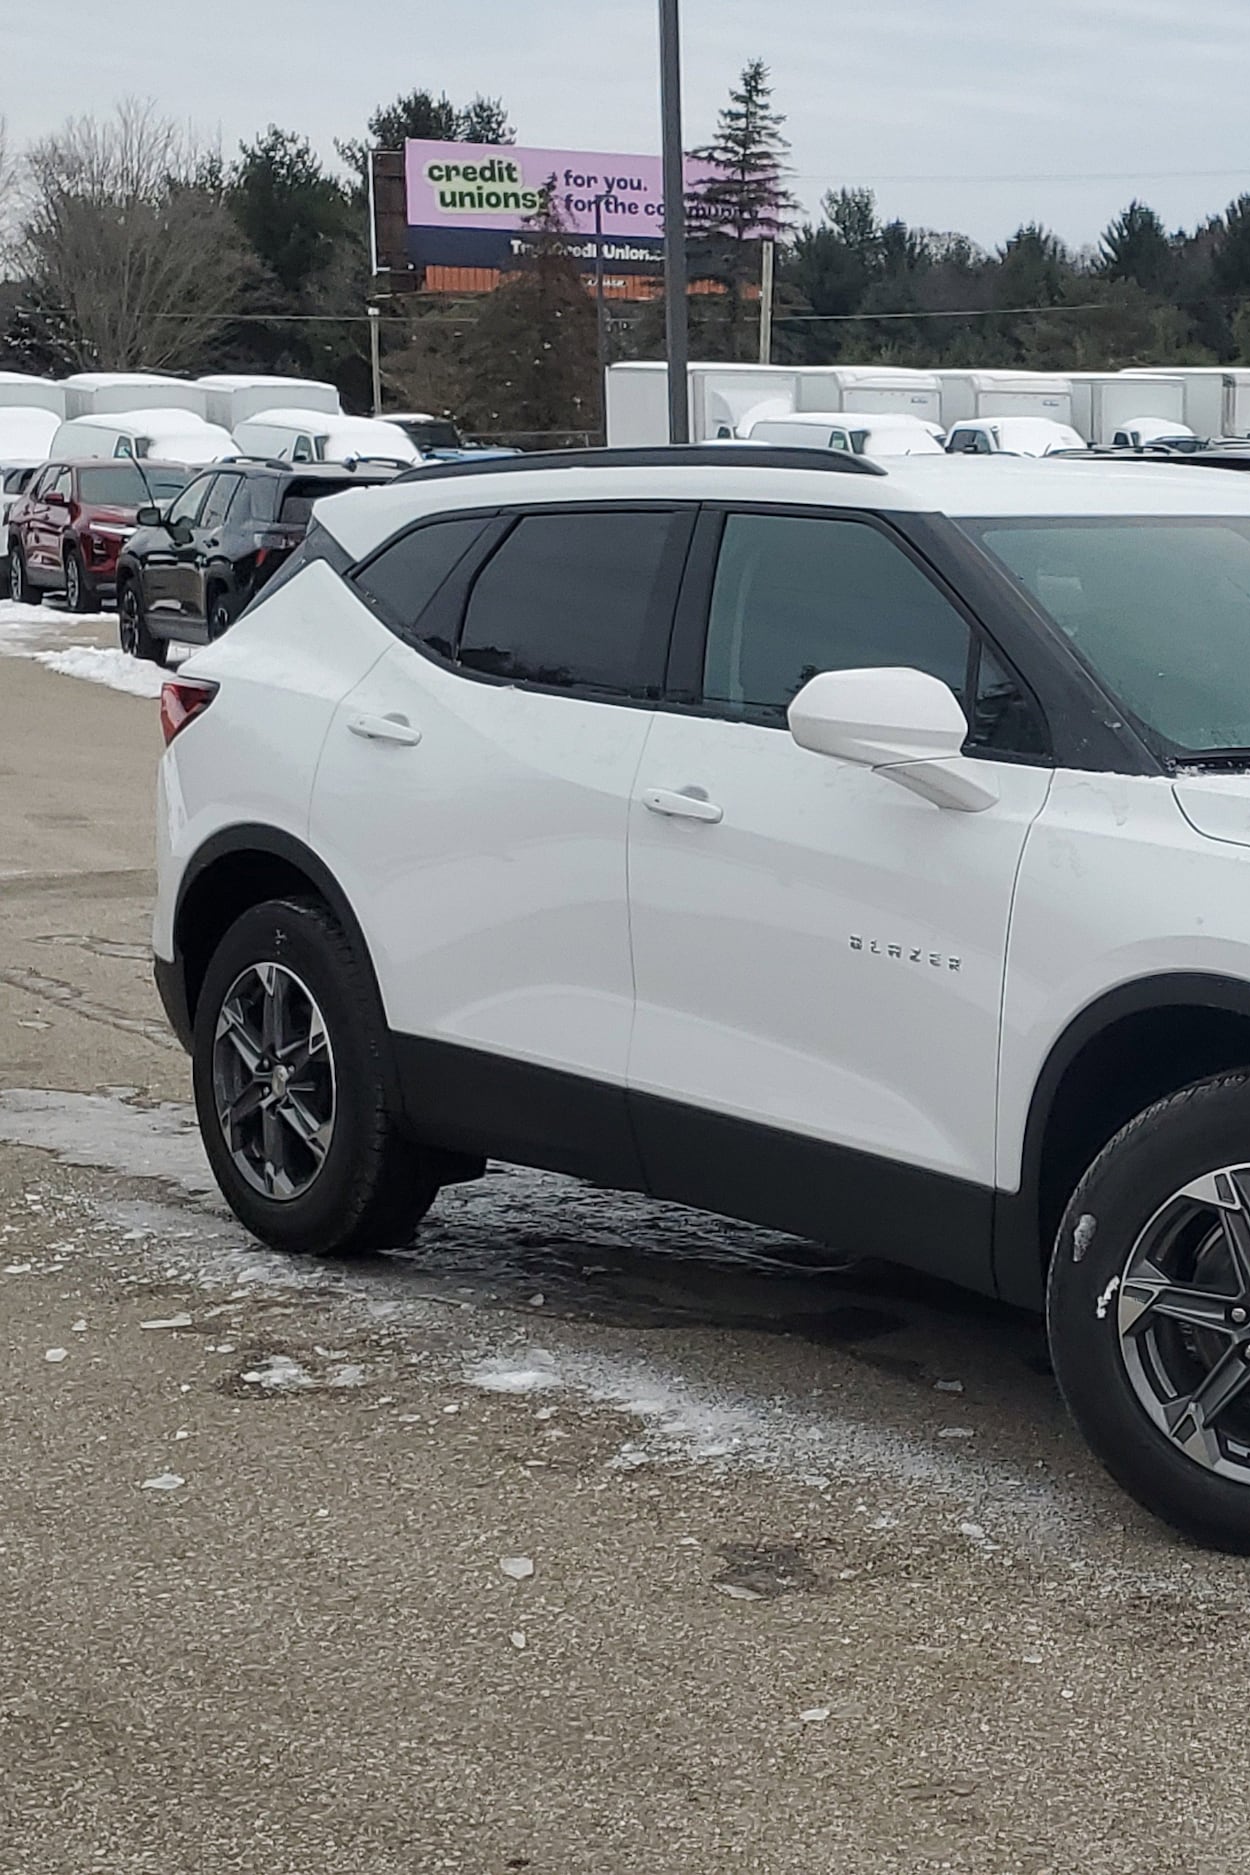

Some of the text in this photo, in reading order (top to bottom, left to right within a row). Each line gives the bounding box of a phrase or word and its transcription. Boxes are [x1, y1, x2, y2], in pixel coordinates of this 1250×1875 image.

[428, 159, 518, 183] credit
[564, 170, 647, 194] for you.
[440, 186, 538, 209] unions
[565, 194, 760, 221] for the comuniy
[850, 936, 960, 971] BLAZER
